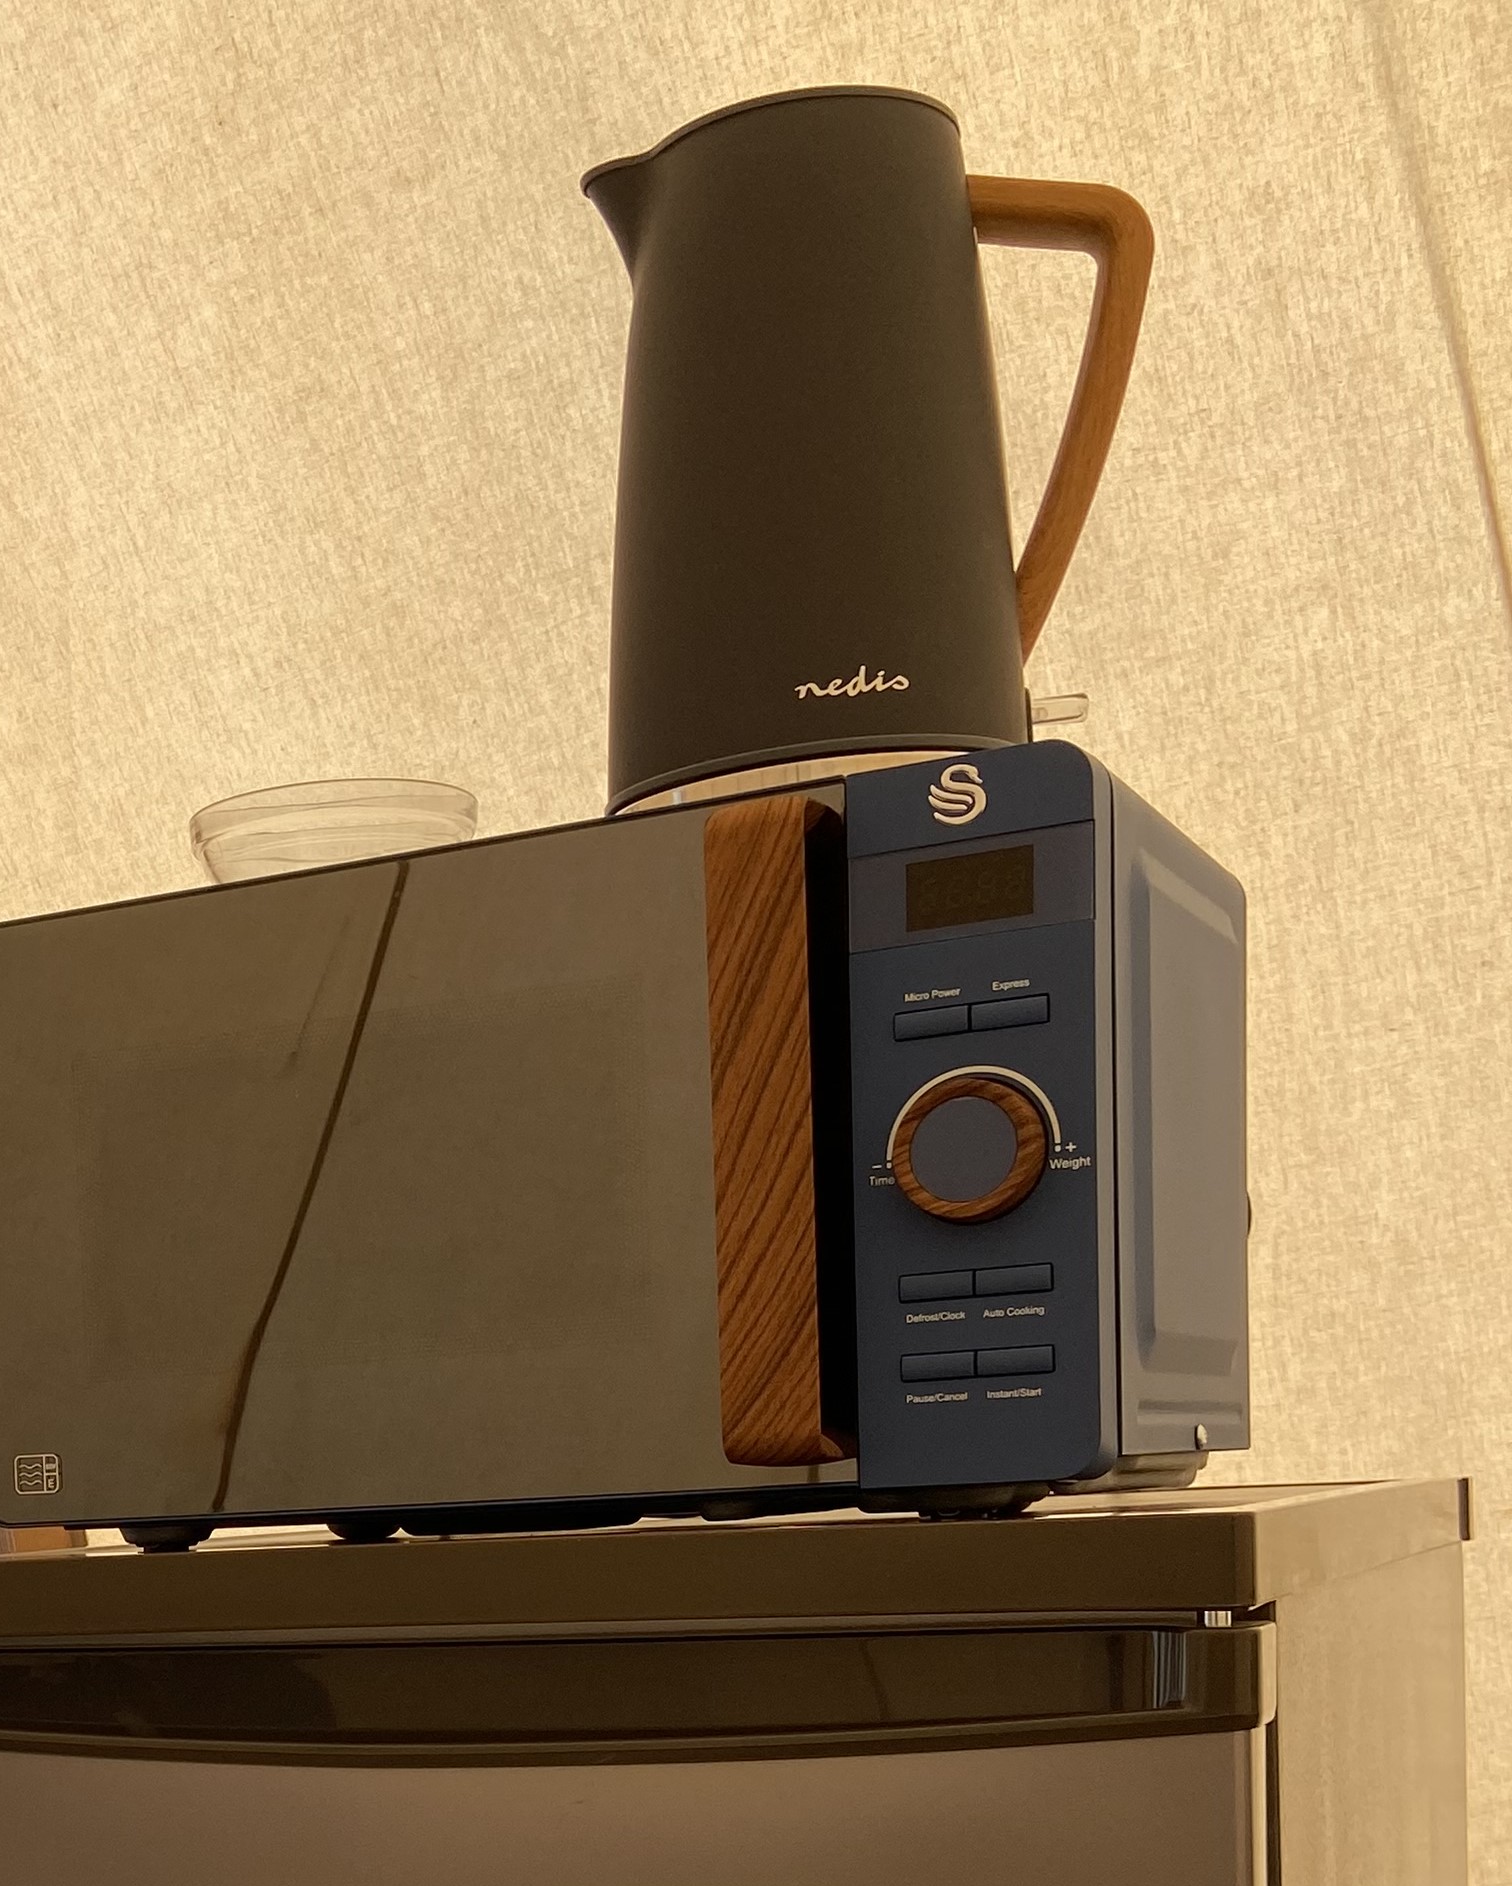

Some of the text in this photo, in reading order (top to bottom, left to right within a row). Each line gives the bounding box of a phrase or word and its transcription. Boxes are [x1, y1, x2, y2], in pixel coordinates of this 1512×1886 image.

[794, 665, 910, 699] nedis
[991, 978, 1030, 992] Express
[904, 987, 961, 1003] Micro Power
[1050, 1155, 1091, 1170] Weight
[869, 1176, 895, 1187] Time
[906, 1311, 966, 1324] Defrost/Clock
[983, 1305, 1045, 1319] Auto Cooking
[906, 1391, 968, 1404] Pause/Cancel
[987, 1387, 1042, 1399] Instant/Start
